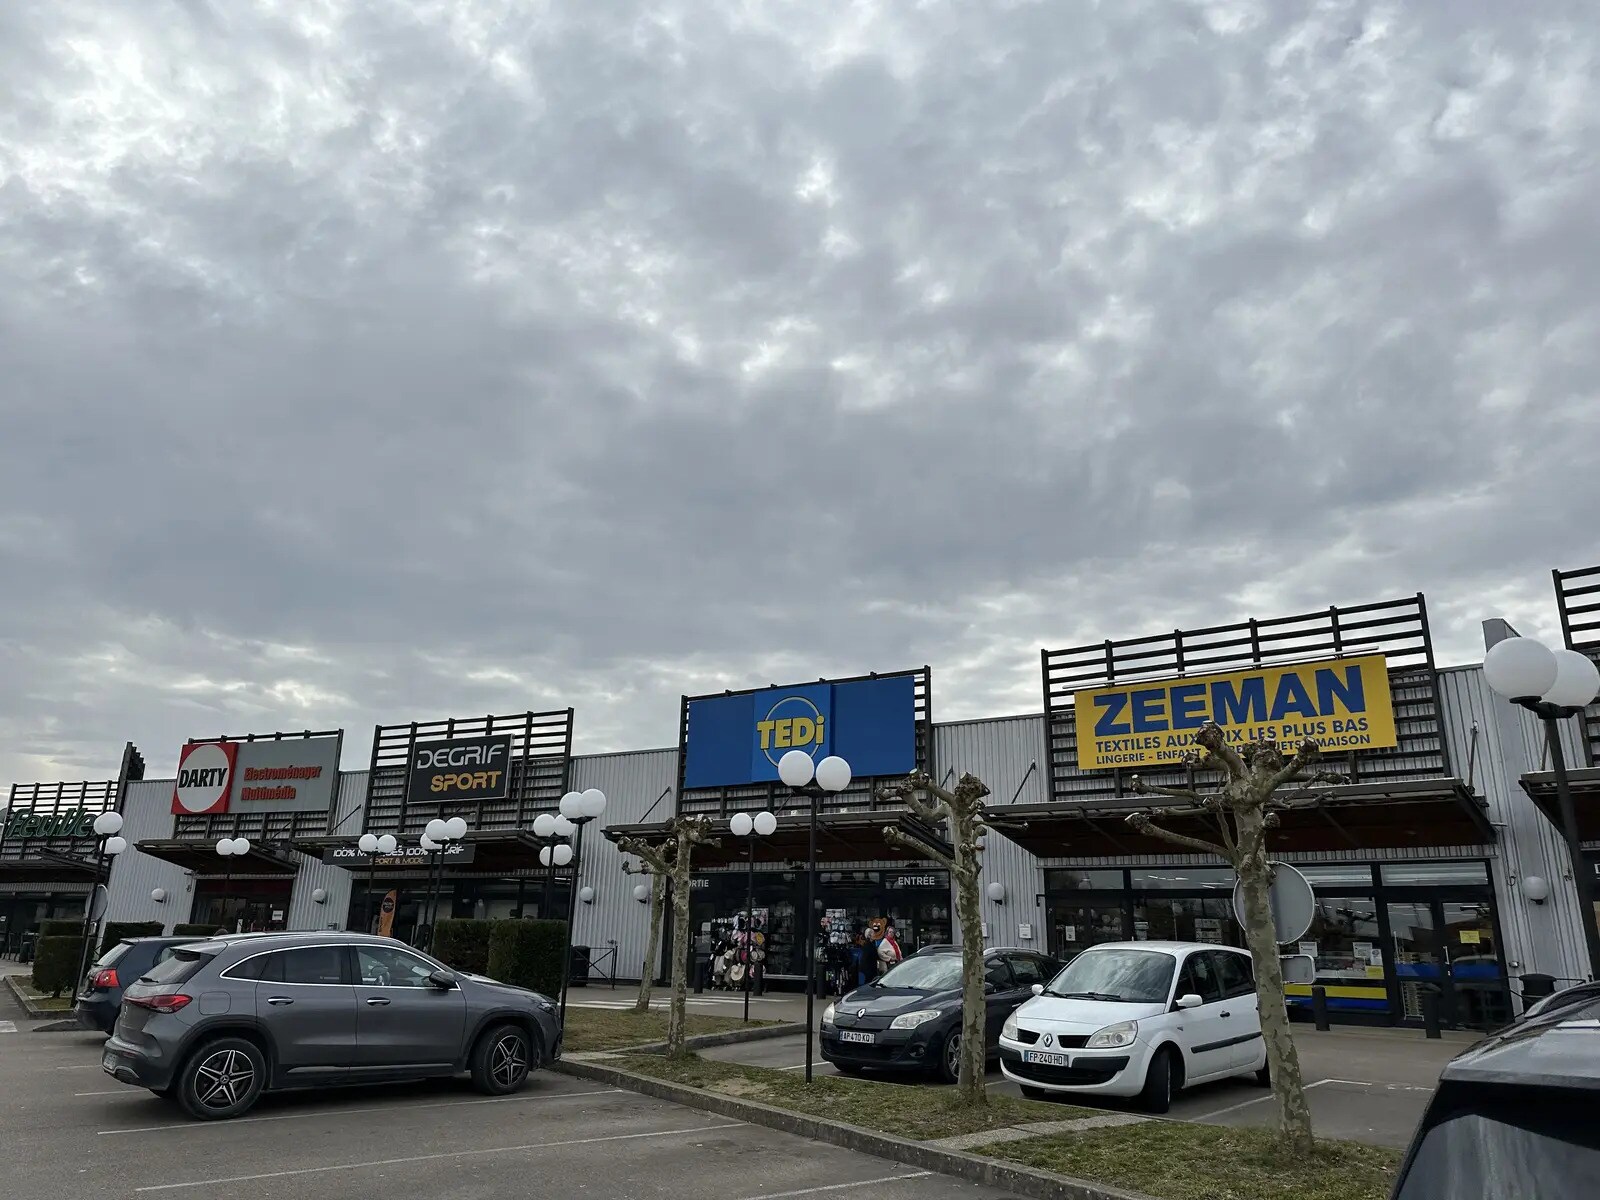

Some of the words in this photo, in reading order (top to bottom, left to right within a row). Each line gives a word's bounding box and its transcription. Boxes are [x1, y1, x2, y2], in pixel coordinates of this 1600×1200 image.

[1093, 665, 1366, 737] ZEEMAN
[757, 715, 825, 749] TEDi
[1096, 736, 1161, 753] TEXTILES
[1166, 733, 1198, 748] AUX
[1249, 726, 1277, 740] LES
[1282, 721, 1327, 738] PLUS
[1332, 717, 1369, 734] BAS
[416, 743, 505, 769] DEGRIF
[1096, 752, 1145, 765] LINGERIE
[1316, 734, 1371, 748] MAISON
[178, 767, 228, 788] DARTY
[430, 770, 502, 792] SPORT
[333, 848, 355, 857] 100%
[405, 847, 428, 856] 100%
[688, 879, 710, 888] RTIE
[897, 874, 936, 886] ENTRÉE
